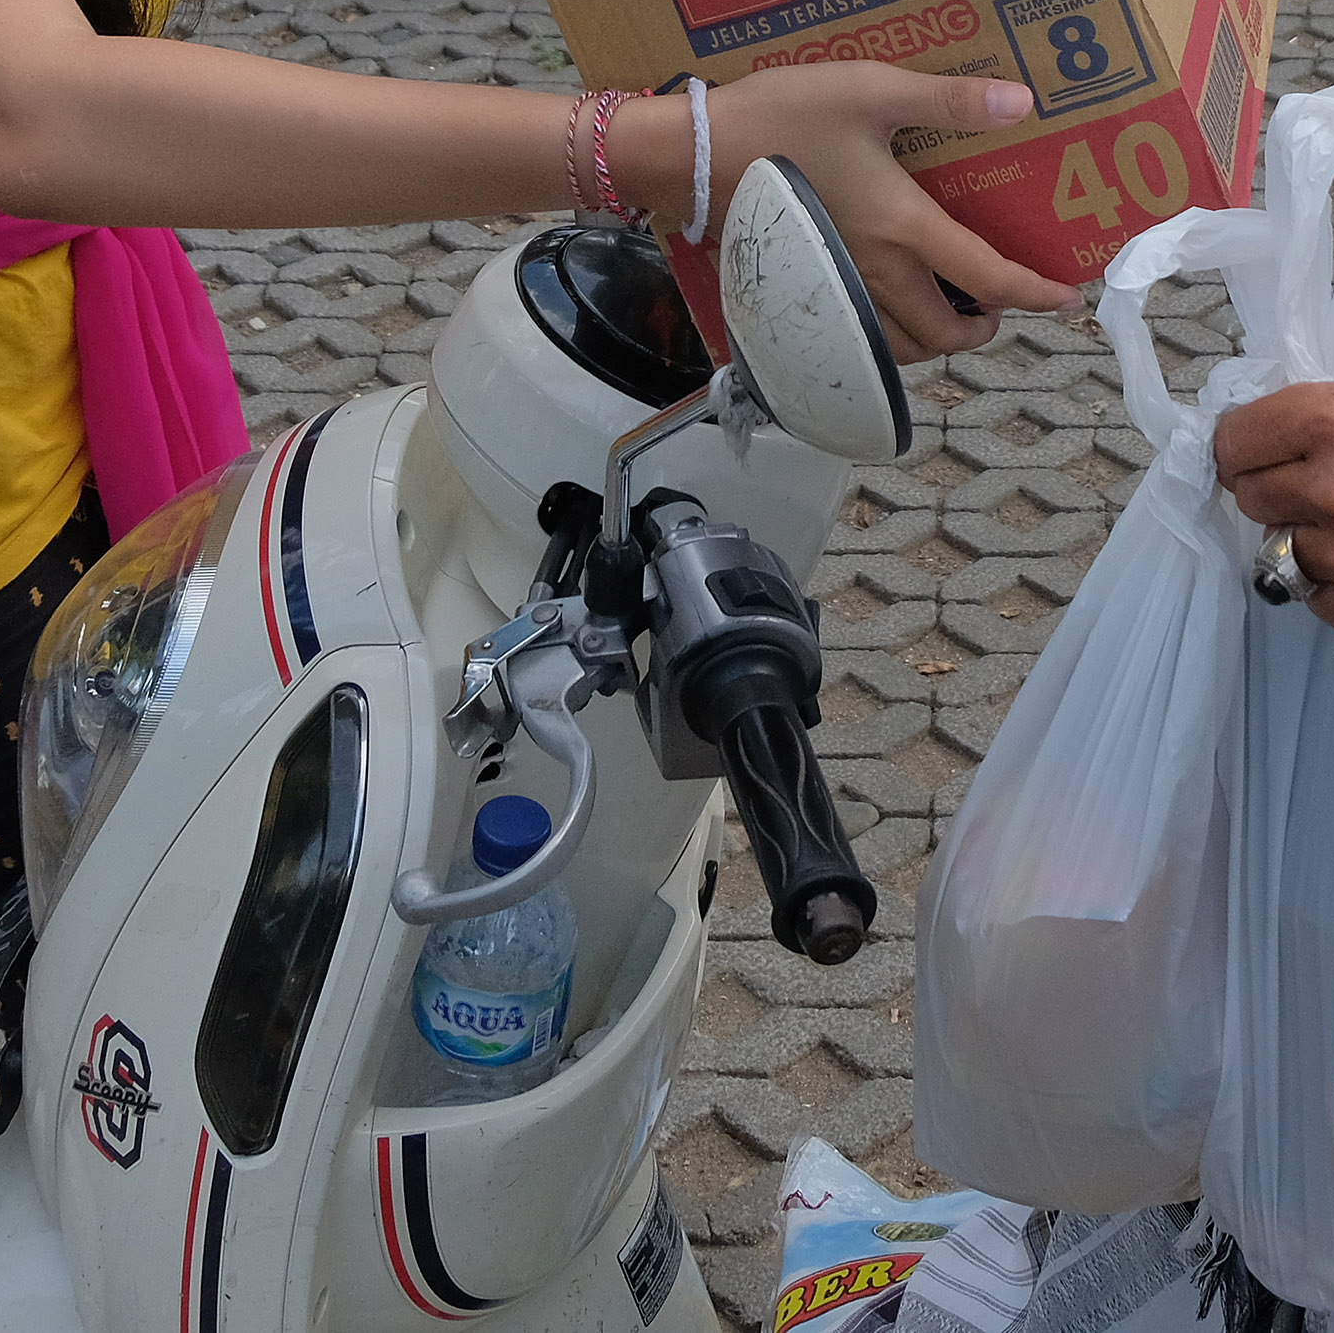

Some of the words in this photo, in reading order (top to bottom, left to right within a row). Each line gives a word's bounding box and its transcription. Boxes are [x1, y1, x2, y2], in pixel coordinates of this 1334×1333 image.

[708, 15, 772, 50] JELAS
[1047, 14, 1110, 82] 8
[907, 130, 945, 155] 61151
[938, 178, 961, 201] Isi
[966, 161, 1025, 193] Content
[1052, 120, 1190, 230] 40
[431, 992, 528, 1038] AQUA
[72, 1061, 163, 1118] Scoopy
[774, 1260, 918, 1333] BER
